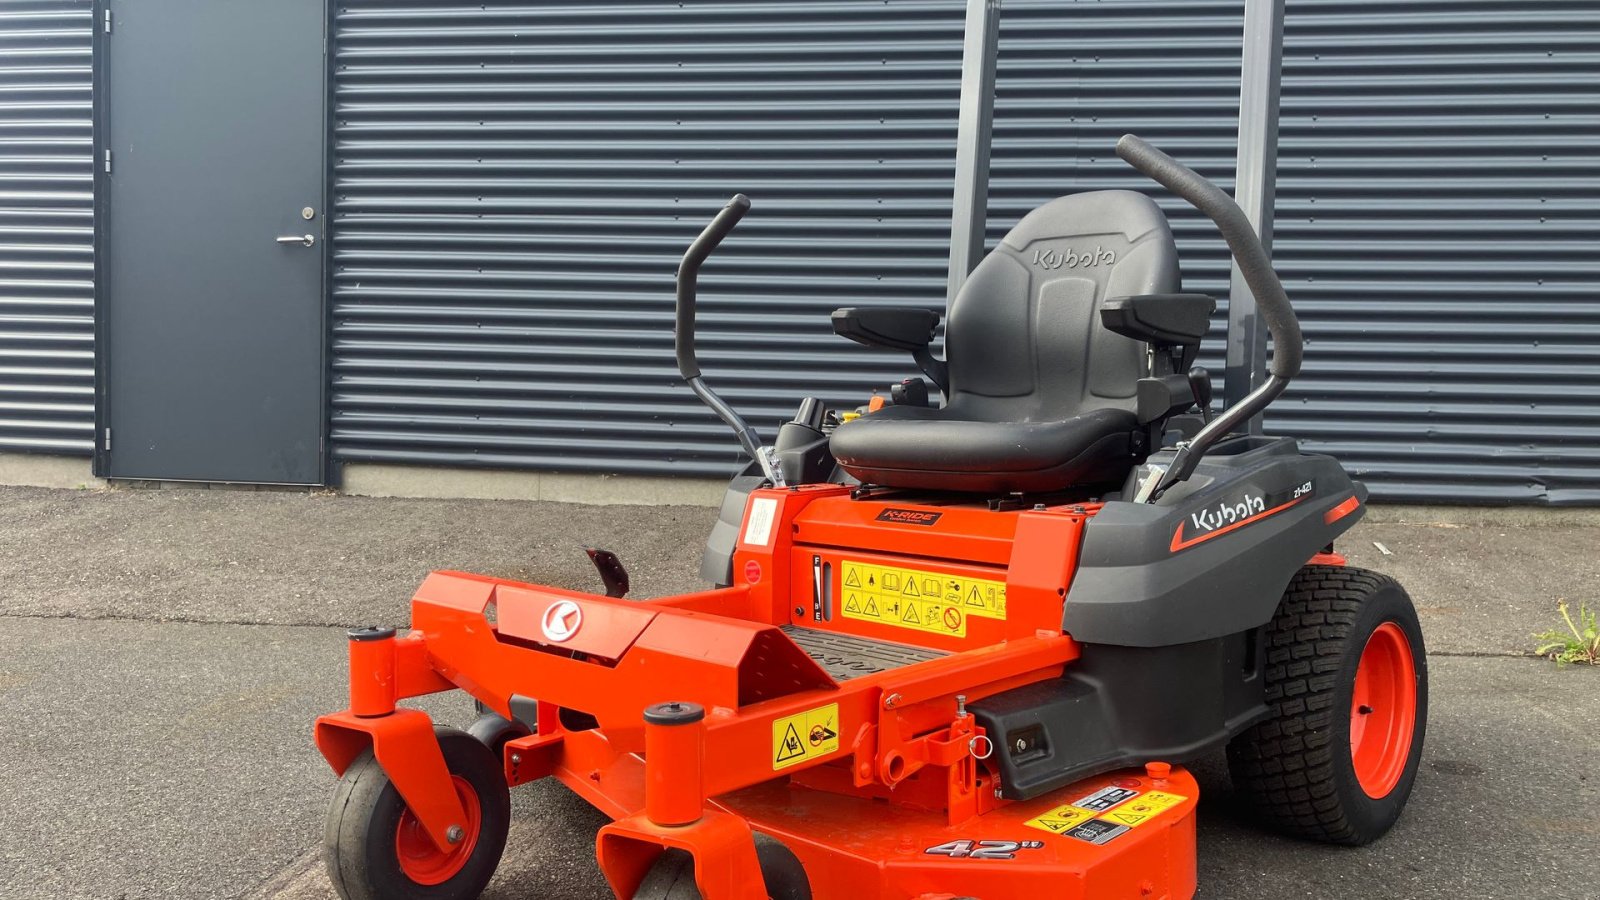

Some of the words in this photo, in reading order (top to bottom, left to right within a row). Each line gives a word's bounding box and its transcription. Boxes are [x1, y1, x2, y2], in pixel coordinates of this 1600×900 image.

[1033, 246, 1116, 270] Kubota
[1191, 494, 1265, 531] Kubota
[814, 557, 820, 565] F
[815, 612, 821, 620] E
[924, 839, 1044, 859] 42"
